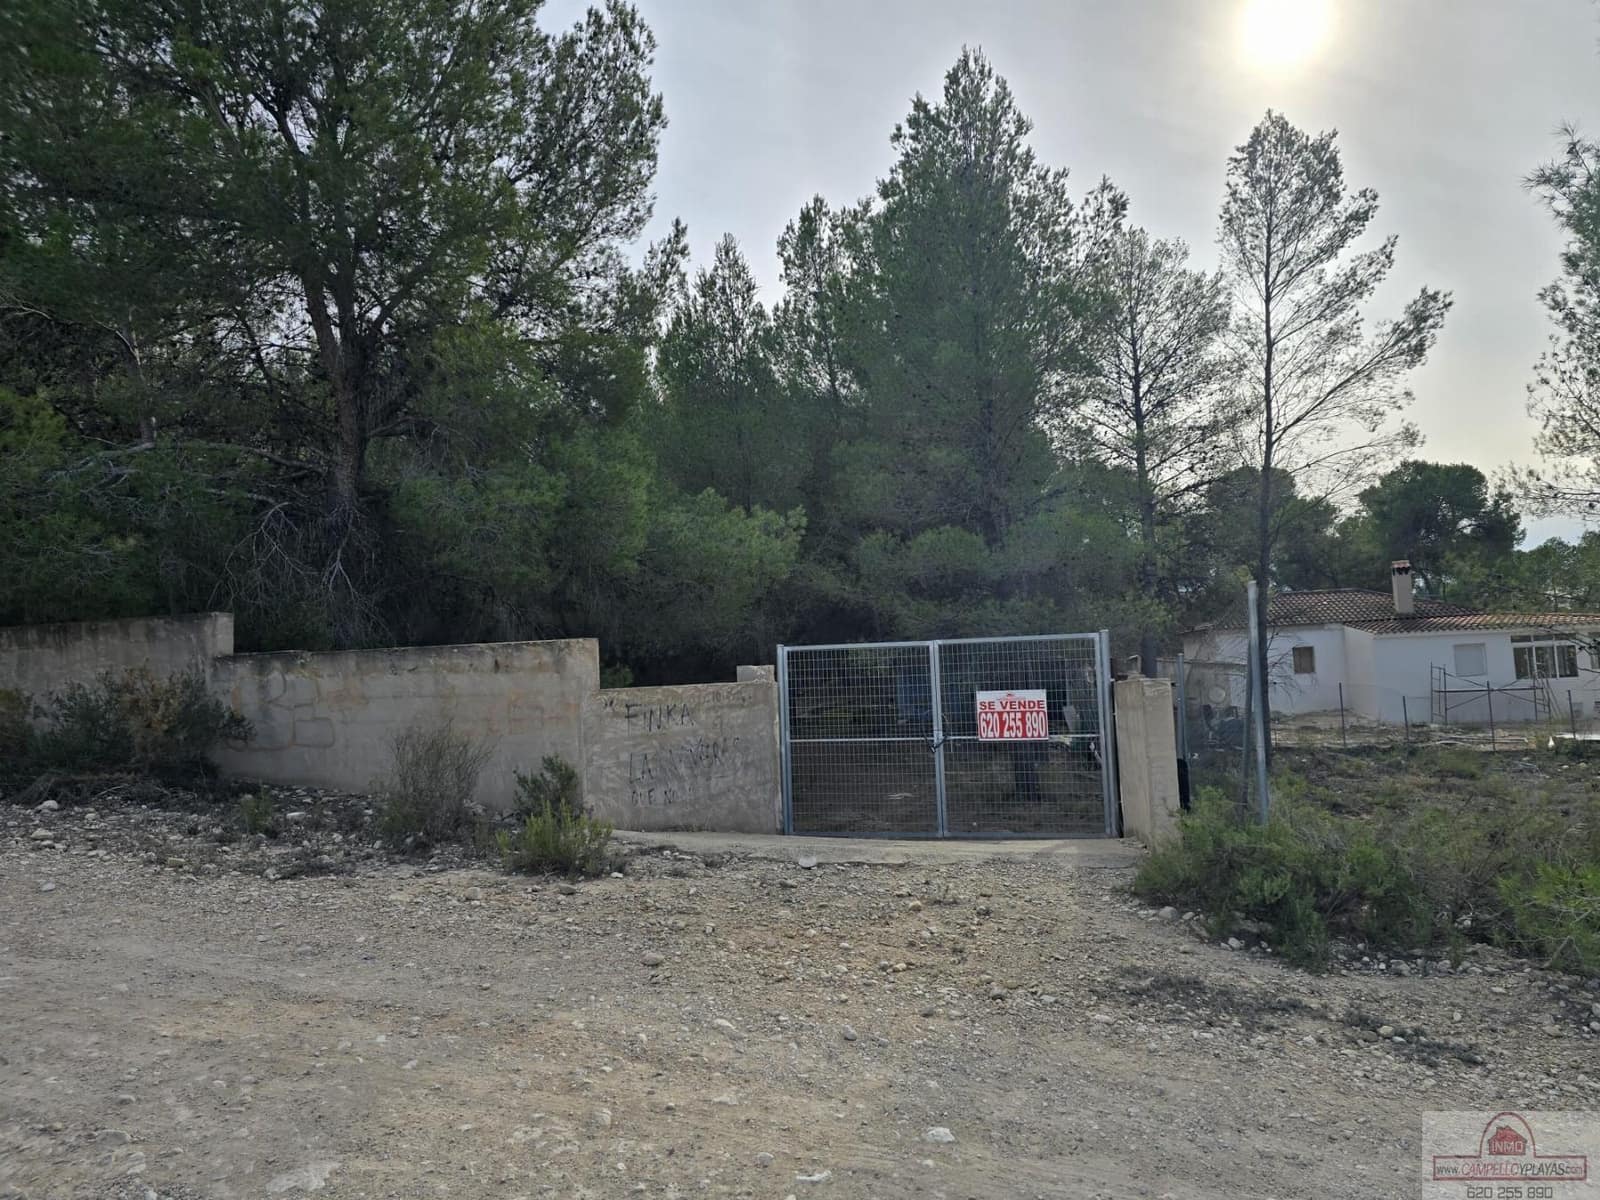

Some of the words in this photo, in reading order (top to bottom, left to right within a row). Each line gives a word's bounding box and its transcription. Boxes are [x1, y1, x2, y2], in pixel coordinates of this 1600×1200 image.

[979, 701, 996, 710] SE
[1000, 700, 1045, 710] VENDE
[980, 712, 1000, 738] 620
[1003, 711, 1023, 738] 255
[1026, 711, 1046, 737] 890
